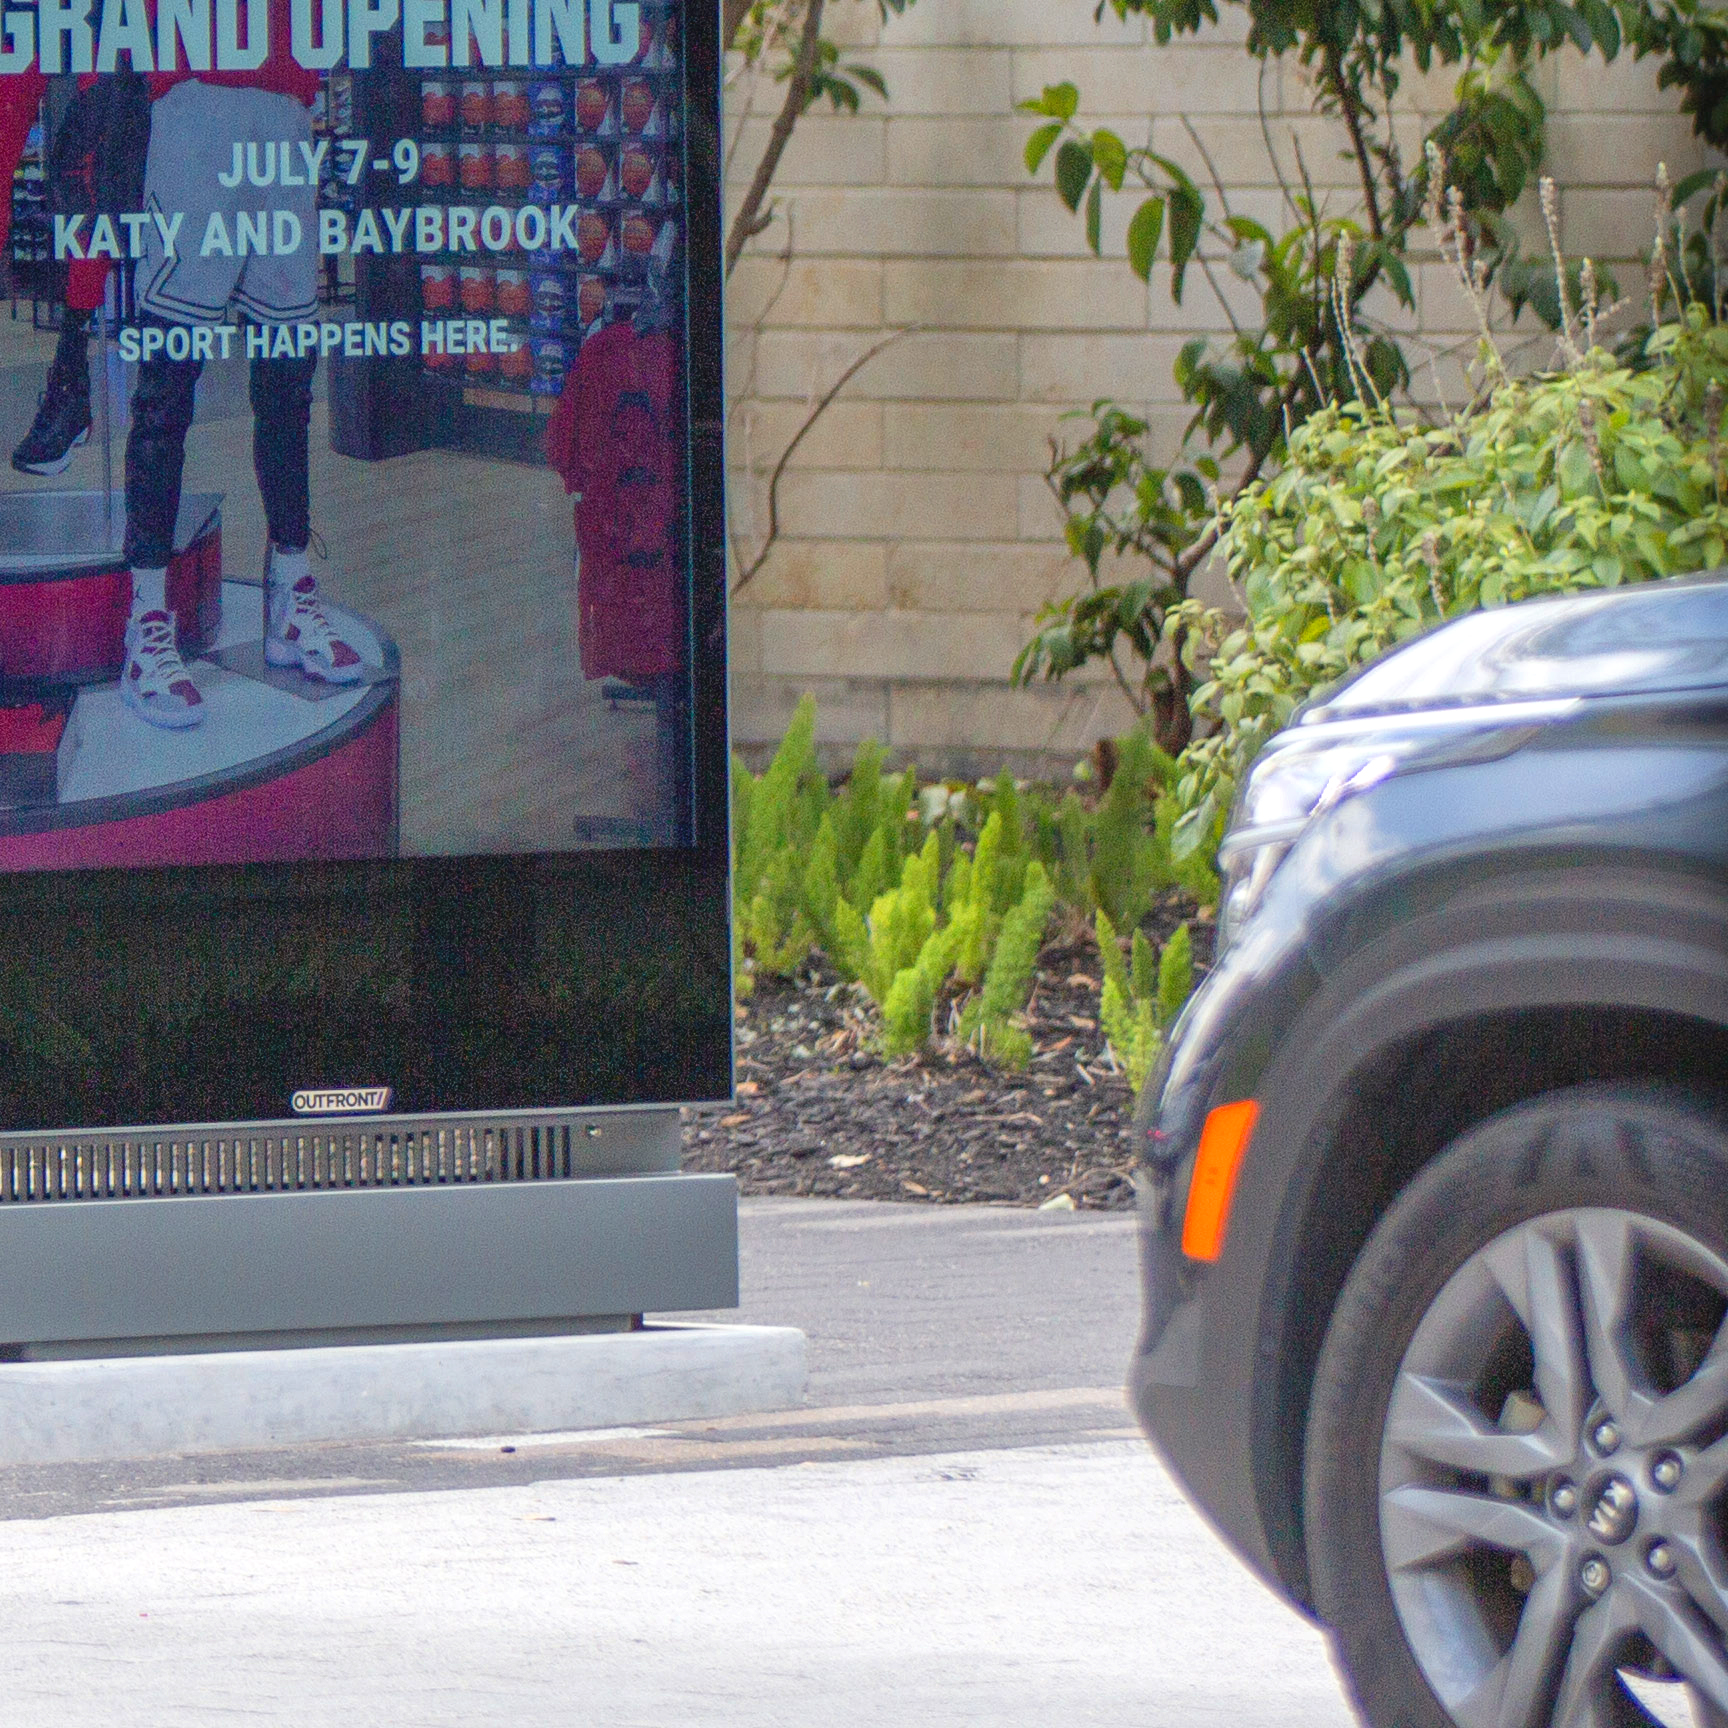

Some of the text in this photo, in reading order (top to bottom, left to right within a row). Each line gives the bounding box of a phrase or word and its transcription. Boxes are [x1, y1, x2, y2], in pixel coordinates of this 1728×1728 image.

[218, 138, 419, 188] JULY 7-9
[53, 204, 580, 260] KATY AND BAYBROOK
[119, 319, 520, 362] SPORT HAPPENS HERE.
